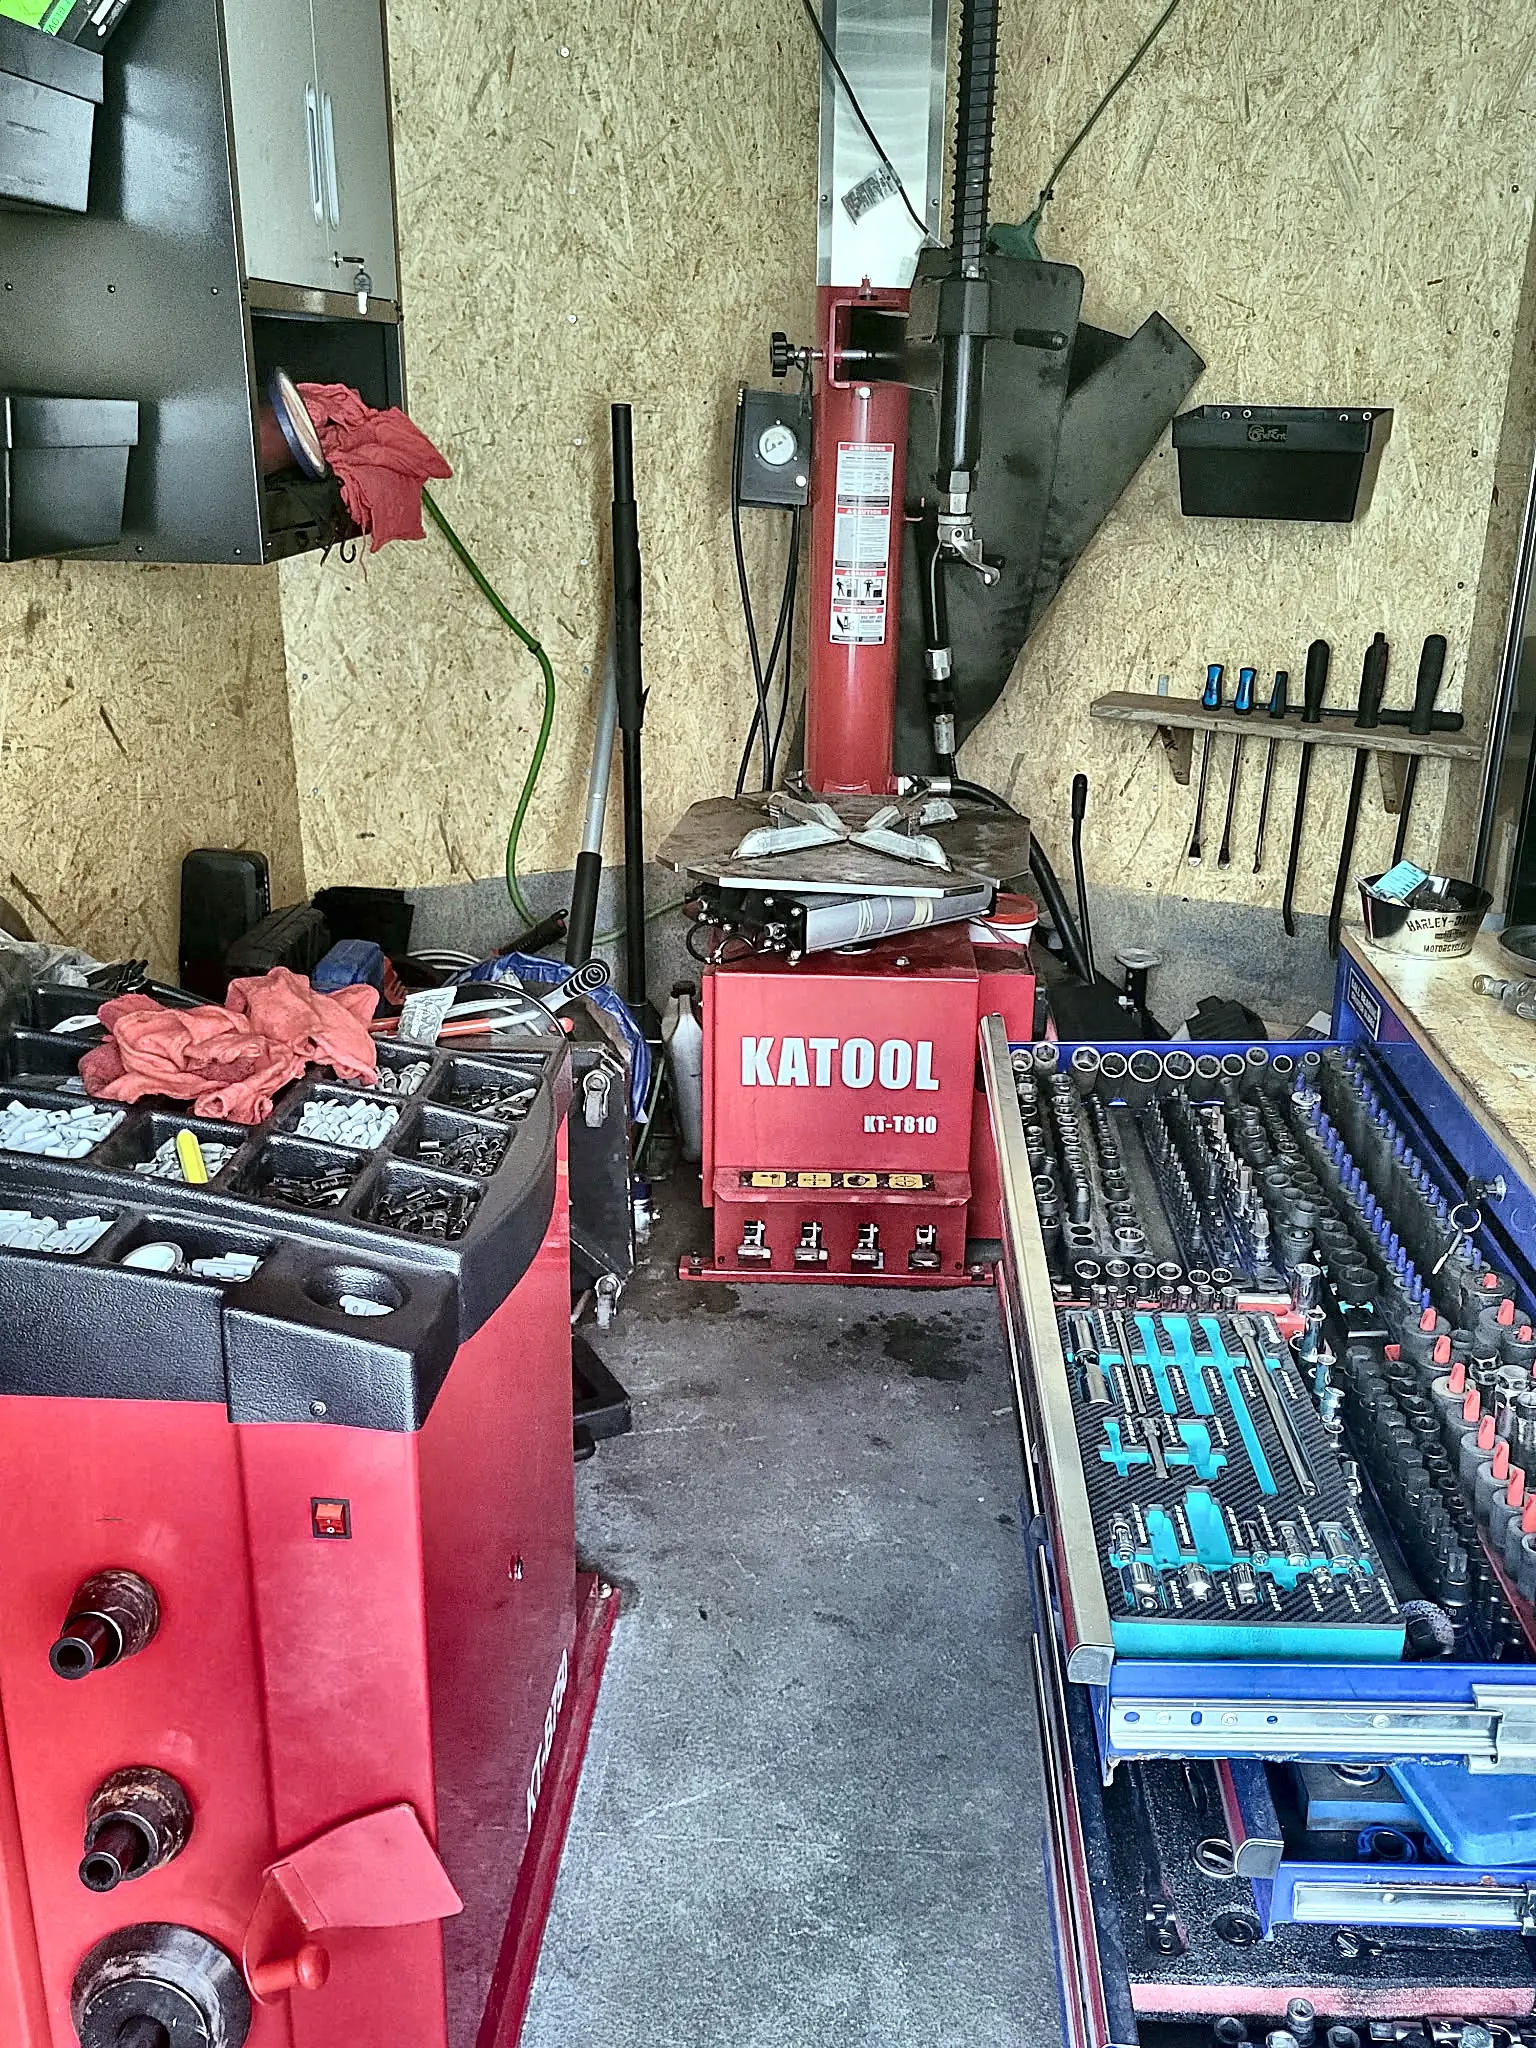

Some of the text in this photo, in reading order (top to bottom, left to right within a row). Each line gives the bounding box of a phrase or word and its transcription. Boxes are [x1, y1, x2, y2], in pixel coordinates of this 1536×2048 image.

[1405, 914, 1479, 932] HARLEY-DA
[741, 1036, 940, 1091] KATOOL
[863, 1115, 937, 1134] KT-T810
